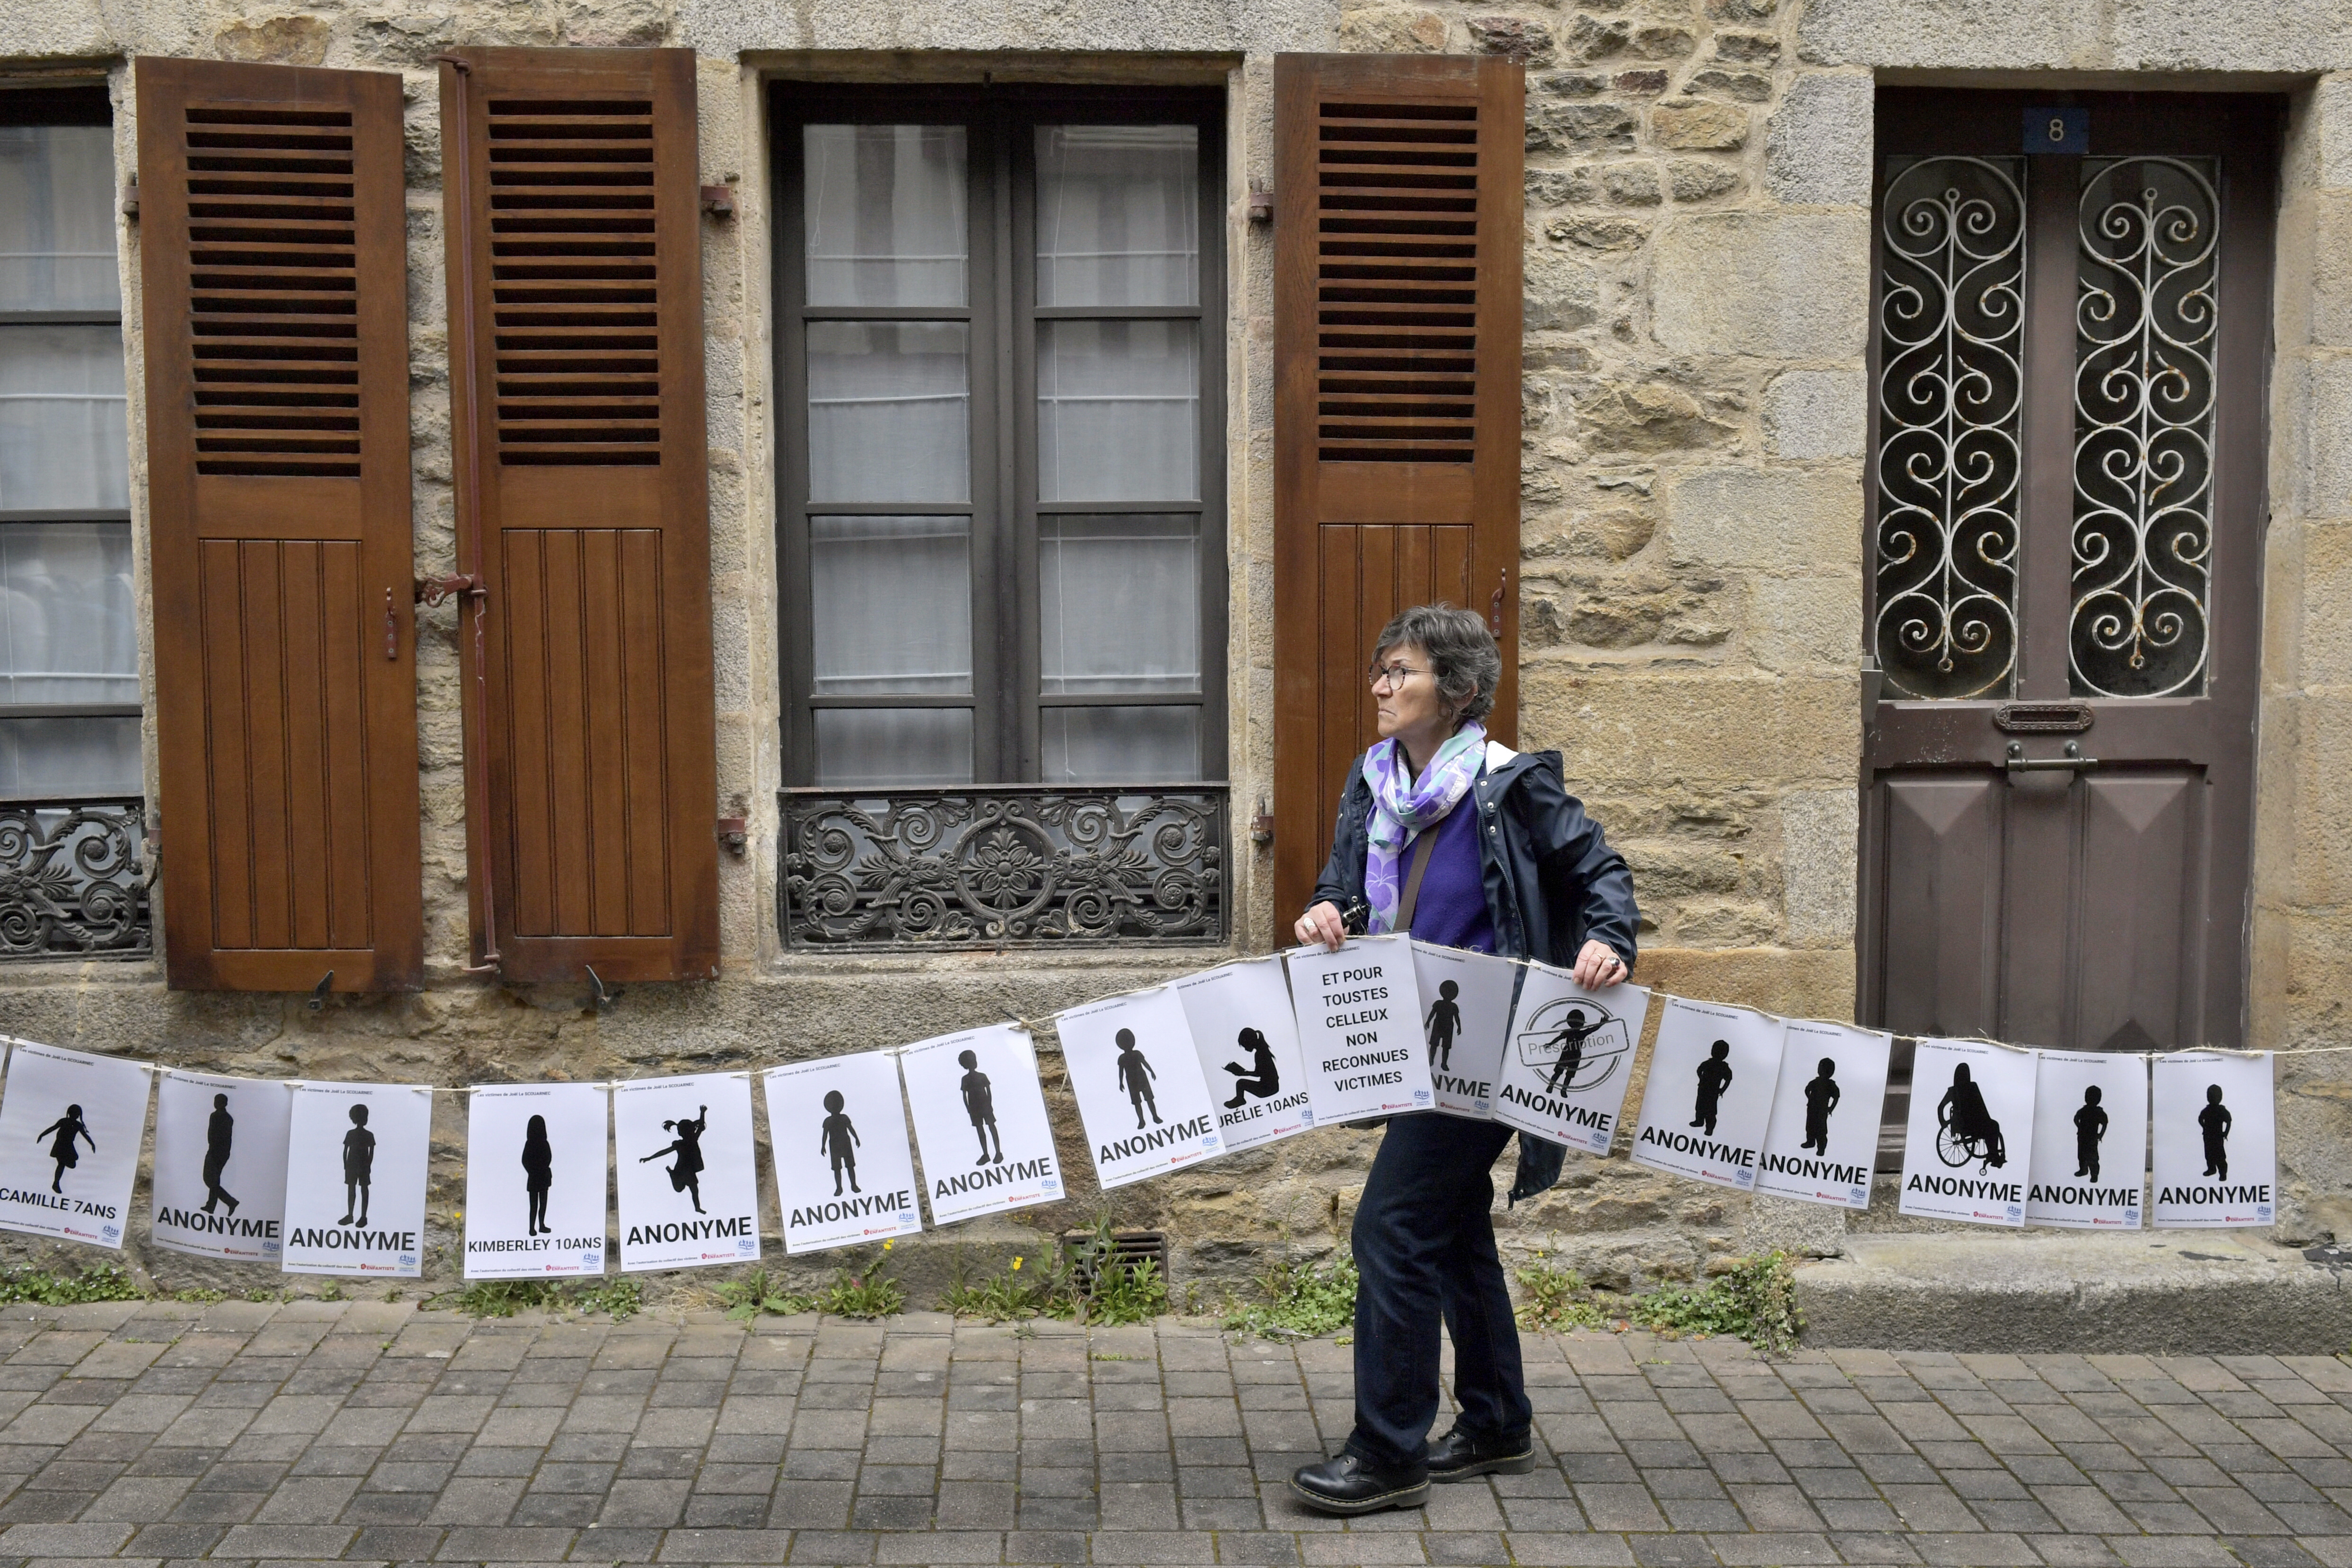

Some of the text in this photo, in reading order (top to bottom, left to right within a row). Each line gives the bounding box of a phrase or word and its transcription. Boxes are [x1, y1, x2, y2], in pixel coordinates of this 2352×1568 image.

[2049, 119, 2063, 141] 8
[1441, 955, 1465, 963] SCOUARNEC
[1210, 972, 1233, 981] SCOUARNEC
[1322, 967, 1382, 985] ET POUR
[1541, 969, 1557, 977] victimes
[1103, 1002, 1127, 1010] SCOUARNEC
[1323, 987, 1388, 1007] TOUSTES
[1327, 1008, 1388, 1028] CELLEUX
[950, 1035, 975, 1044] SCOUARNEC
[1346, 1032, 1377, 1046] NON
[1528, 1034, 1614, 1055] Prescription
[67, 1058, 94, 1066] SCOUARNEC
[815, 1063, 840, 1071] SCOUARNEC
[1323, 1049, 1408, 1072] RECONNUES
[1335, 1071, 1402, 1091] VICTIMES
[1431, 1073, 1491, 1098] NYME
[1220, 1092, 1308, 1128] URÉLIE 10ANS
[1500, 1085, 1612, 1131] ANONYME
[1101, 1115, 1212, 1164] ANONYME
[1640, 1126, 1755, 1167] ANONYME
[936, 1157, 1052, 1199] ANONYME
[1907, 1174, 2021, 1202] ANONYME
[0, 1188, 116, 1218] CAMILLE 7ANS
[2028, 1184, 2138, 1206] ANONYME
[2159, 1185, 2269, 1204] ANONYME
[790, 1190, 911, 1228] ANONYME
[157, 1207, 279, 1238] ANONYME
[627, 1217, 752, 1245] ANONYME
[289, 1228, 415, 1251] ANONYME
[469, 1237, 601, 1252] KIMBERLEY 10ANS
